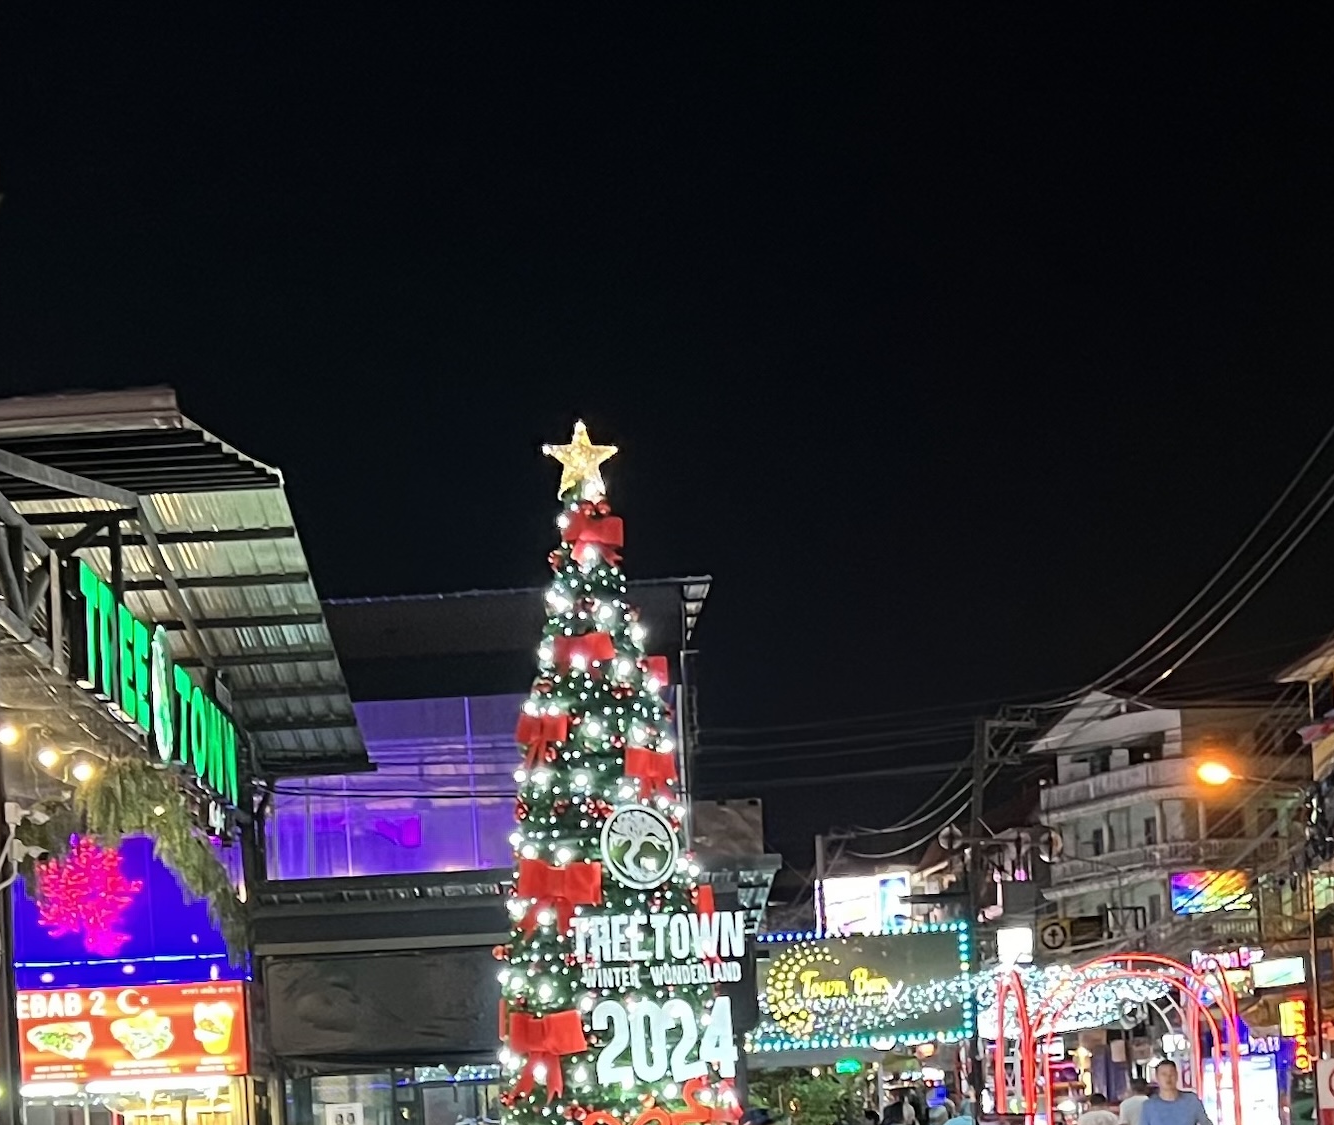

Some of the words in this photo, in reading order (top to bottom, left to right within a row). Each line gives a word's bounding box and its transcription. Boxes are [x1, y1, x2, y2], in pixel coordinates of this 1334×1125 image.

[174, 664, 238, 807] TOWN
[17, 992, 82, 1020] EBAB
[89, 990, 106, 1016] 2
[582, 966, 641, 989] WINTER
[650, 961, 742, 986] WONDERLAND
[592, 996, 739, 1087] 2024
